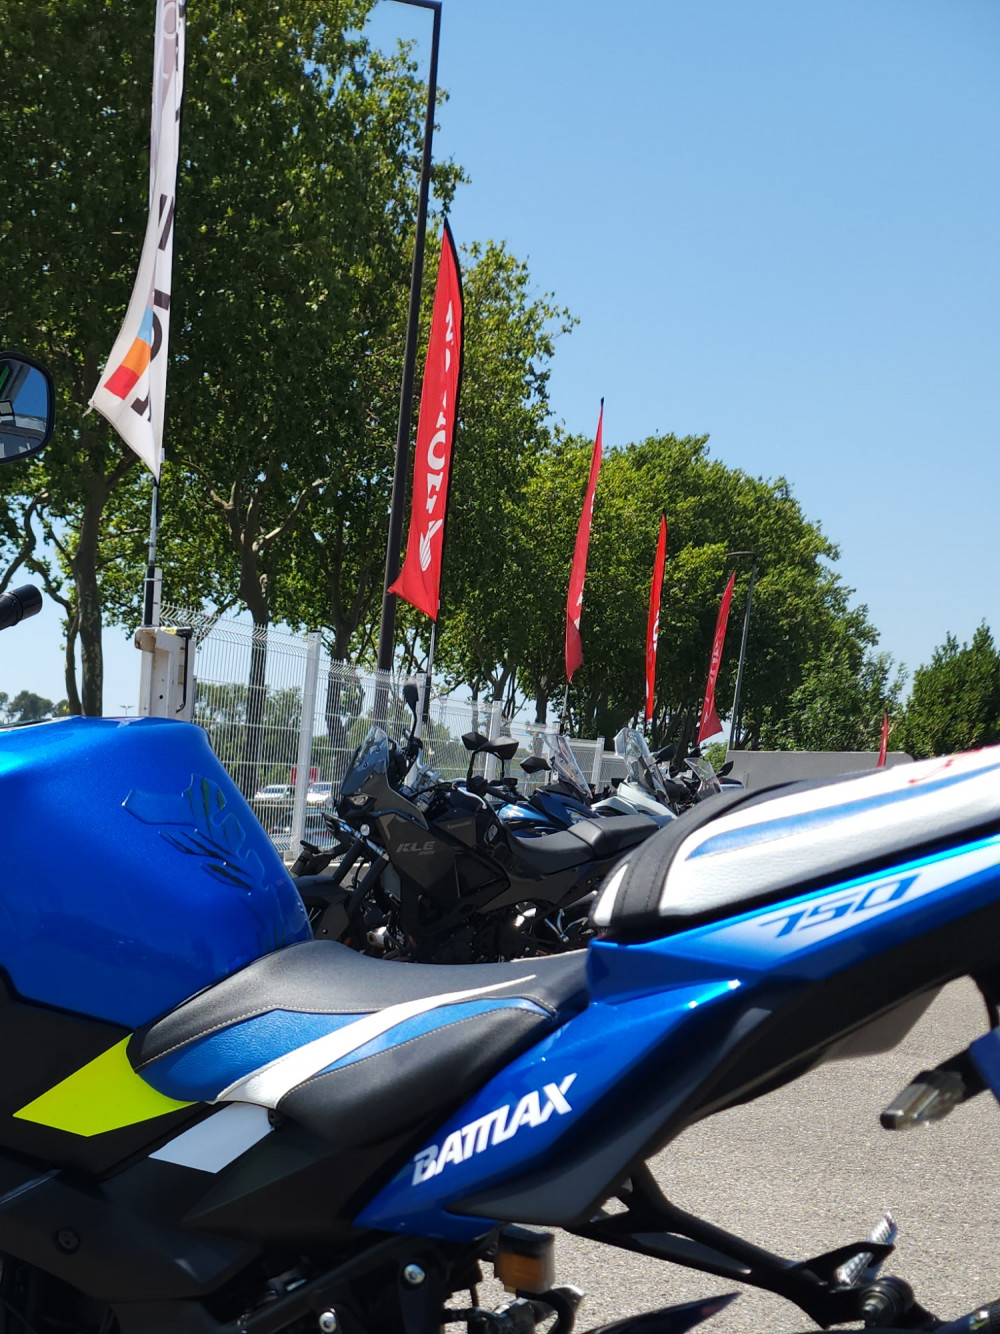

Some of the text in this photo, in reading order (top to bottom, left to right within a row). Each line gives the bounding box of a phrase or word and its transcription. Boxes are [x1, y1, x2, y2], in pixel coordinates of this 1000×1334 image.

[396, 841, 436, 853] KLE
[759, 873, 922, 939] 750
[411, 1072, 578, 1187] BATTLAX
